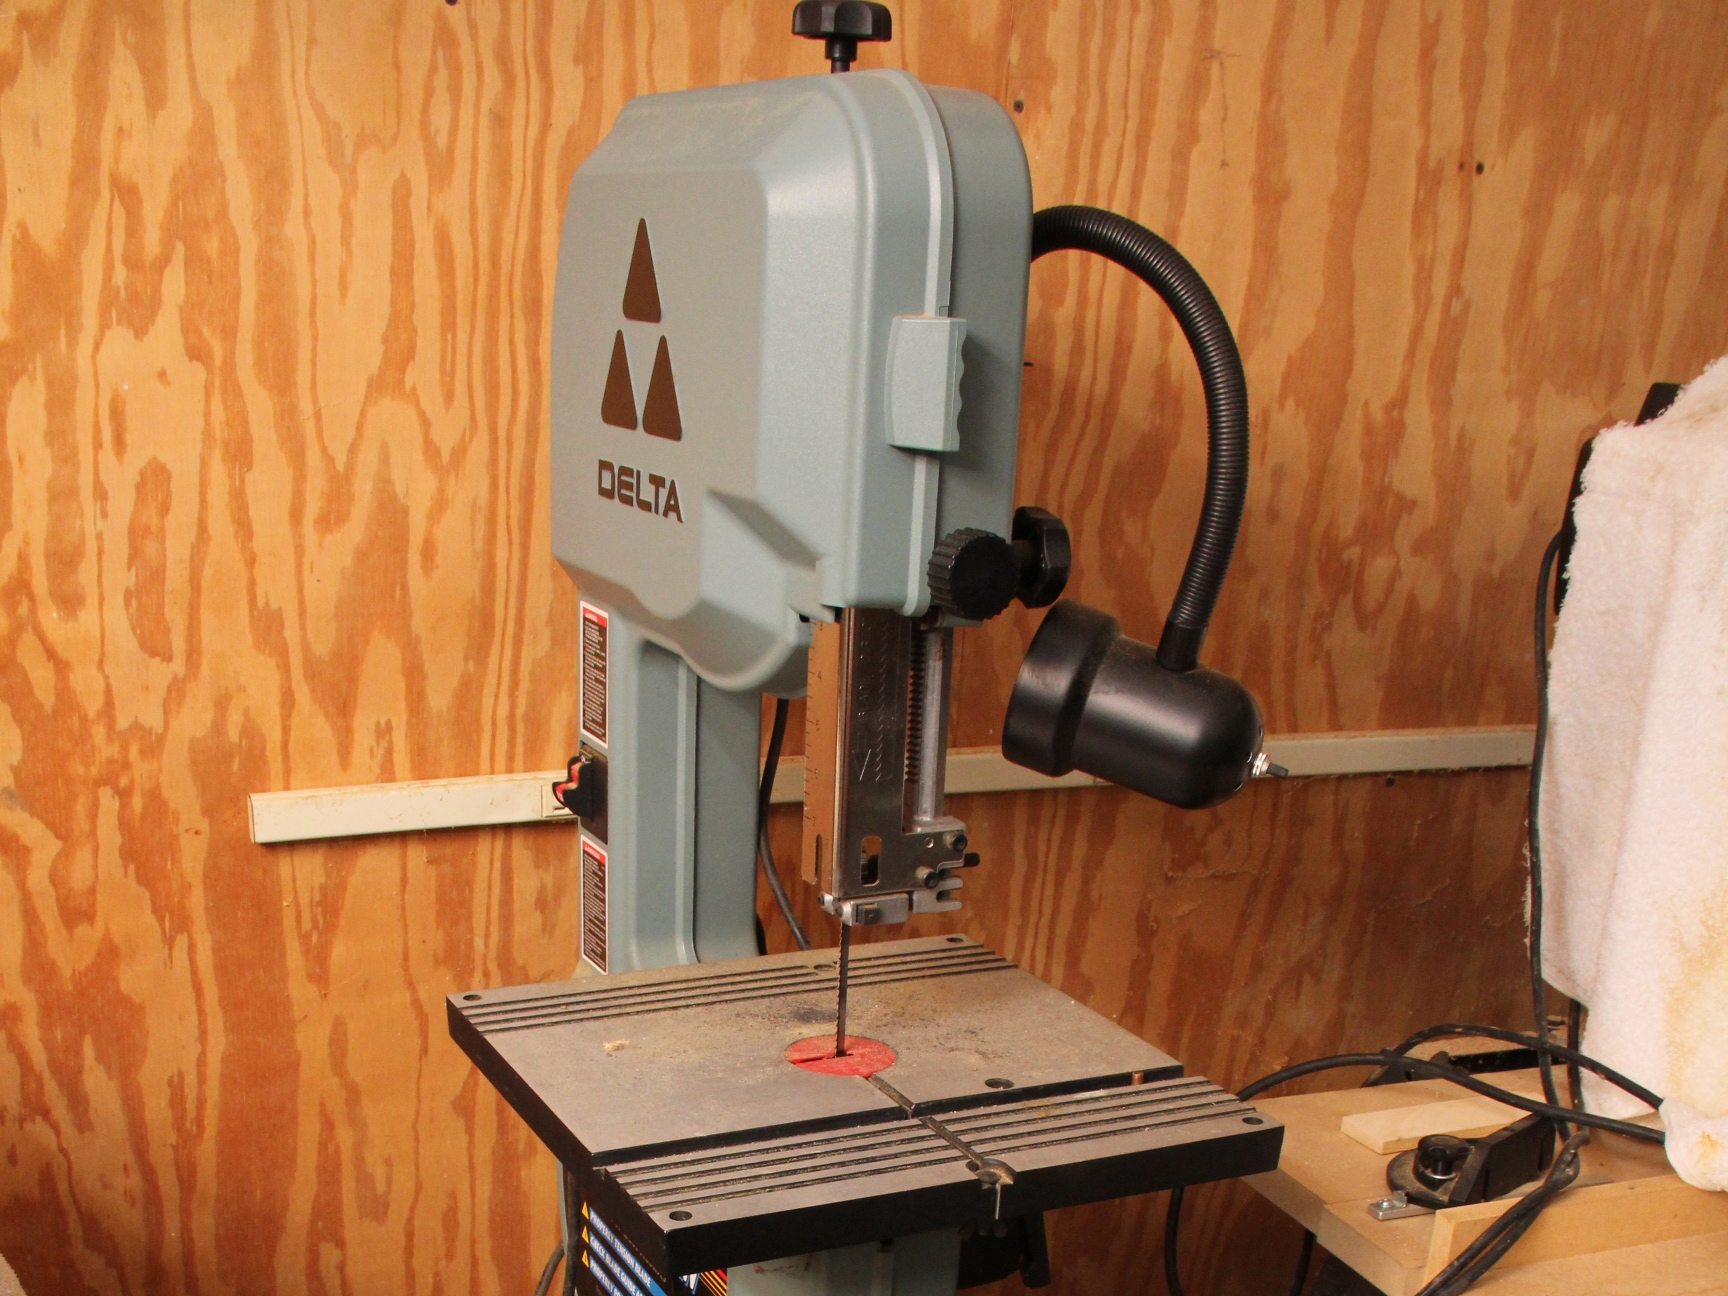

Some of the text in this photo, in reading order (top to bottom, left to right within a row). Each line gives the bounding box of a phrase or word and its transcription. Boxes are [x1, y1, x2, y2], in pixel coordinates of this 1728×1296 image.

[598, 458, 684, 524] DELTA
[590, 1211, 651, 1288] PROPERLY TENSION BLADE
[590, 1236, 605, 1259] CHECK
[605, 1253, 621, 1277] BLADE
[620, 1273, 636, 1295] GUIDE
[590, 1261, 614, 1293] PROPERLY
